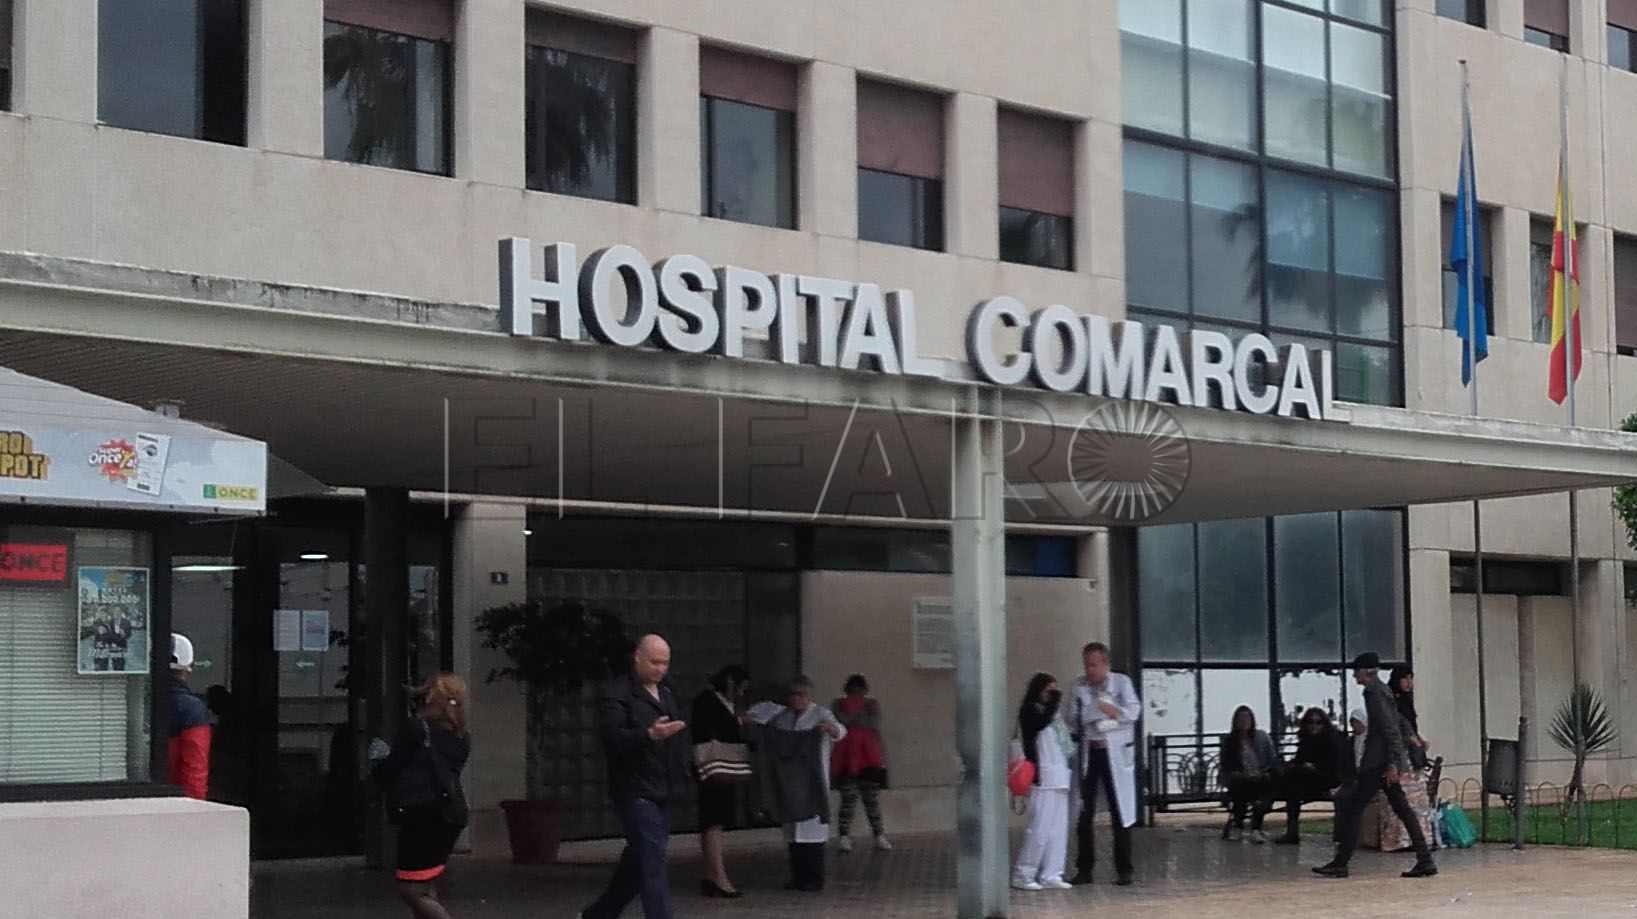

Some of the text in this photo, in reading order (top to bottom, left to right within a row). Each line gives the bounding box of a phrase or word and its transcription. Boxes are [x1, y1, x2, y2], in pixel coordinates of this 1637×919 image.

[498, 236, 1352, 422] HOSPITAL COMARCAL
[218, 486, 257, 500] ONCE
